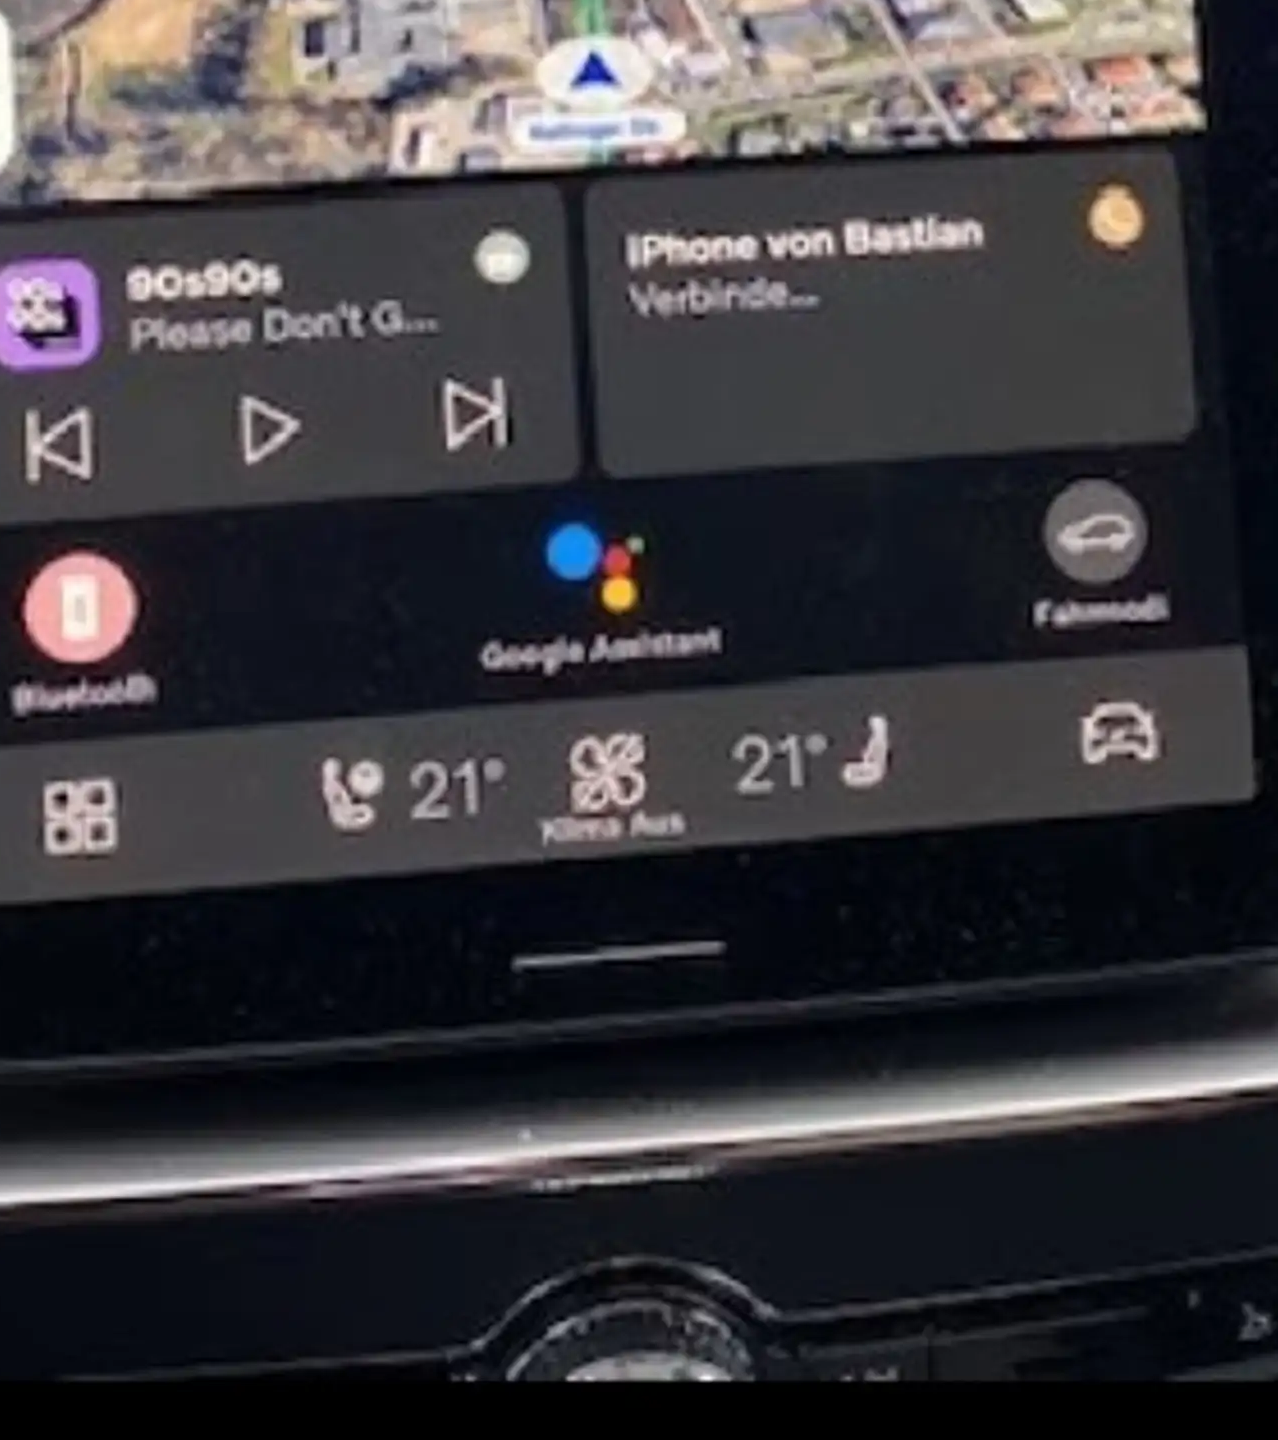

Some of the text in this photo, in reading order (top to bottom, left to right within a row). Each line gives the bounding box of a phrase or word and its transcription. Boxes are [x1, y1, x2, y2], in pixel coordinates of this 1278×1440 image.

[767, 227, 833, 258] von
[843, 214, 984, 256] Bastian
[126, 259, 282, 302] 90s90s
[130, 316, 253, 353] Please
[262, 298, 366, 343] Don't
[480, 624, 724, 677] Google Assistant
[410, 757, 506, 820] 21°
[731, 734, 827, 794] 21°
[629, 809, 687, 839] Aus
